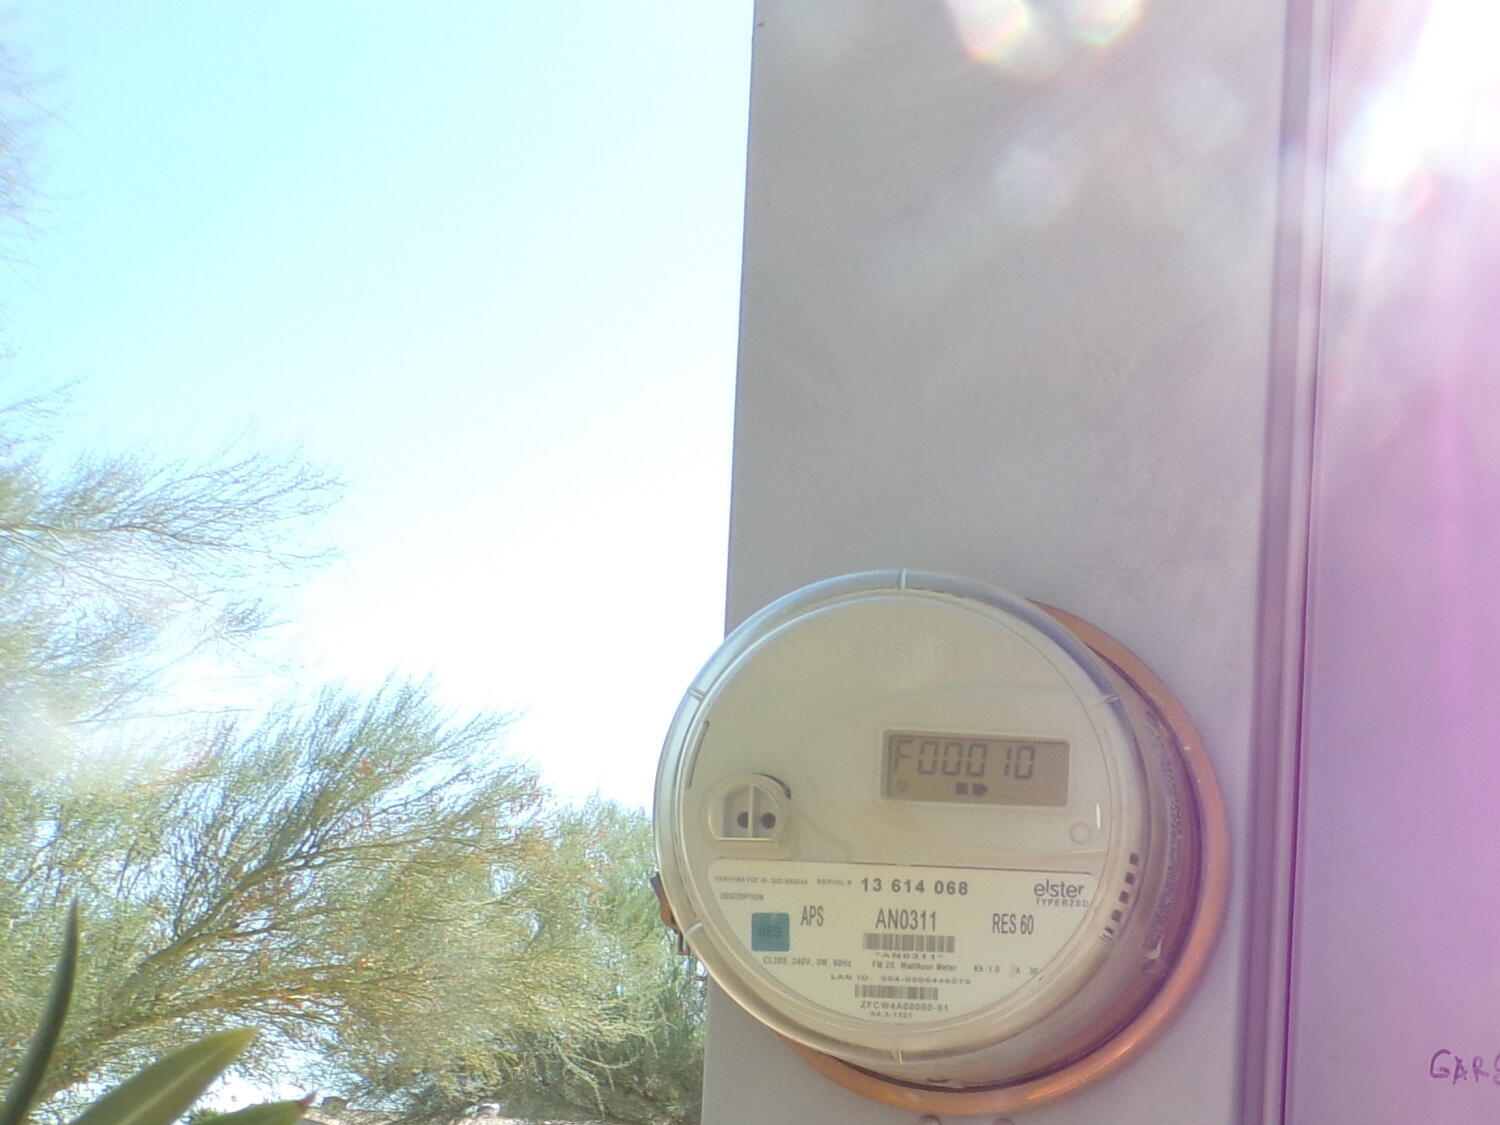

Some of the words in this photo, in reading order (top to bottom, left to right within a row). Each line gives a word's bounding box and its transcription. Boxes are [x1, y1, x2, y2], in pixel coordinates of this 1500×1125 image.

[861, 877, 882, 892] 13
[891, 879, 925, 894] 614
[934, 880, 968, 896] 068
[1033, 878, 1085, 899] elster
[800, 905, 824, 927] APS
[875, 908, 936, 931] AN0311
[992, 913, 1017, 934] RES
[1020, 915, 1034, 935] 60
